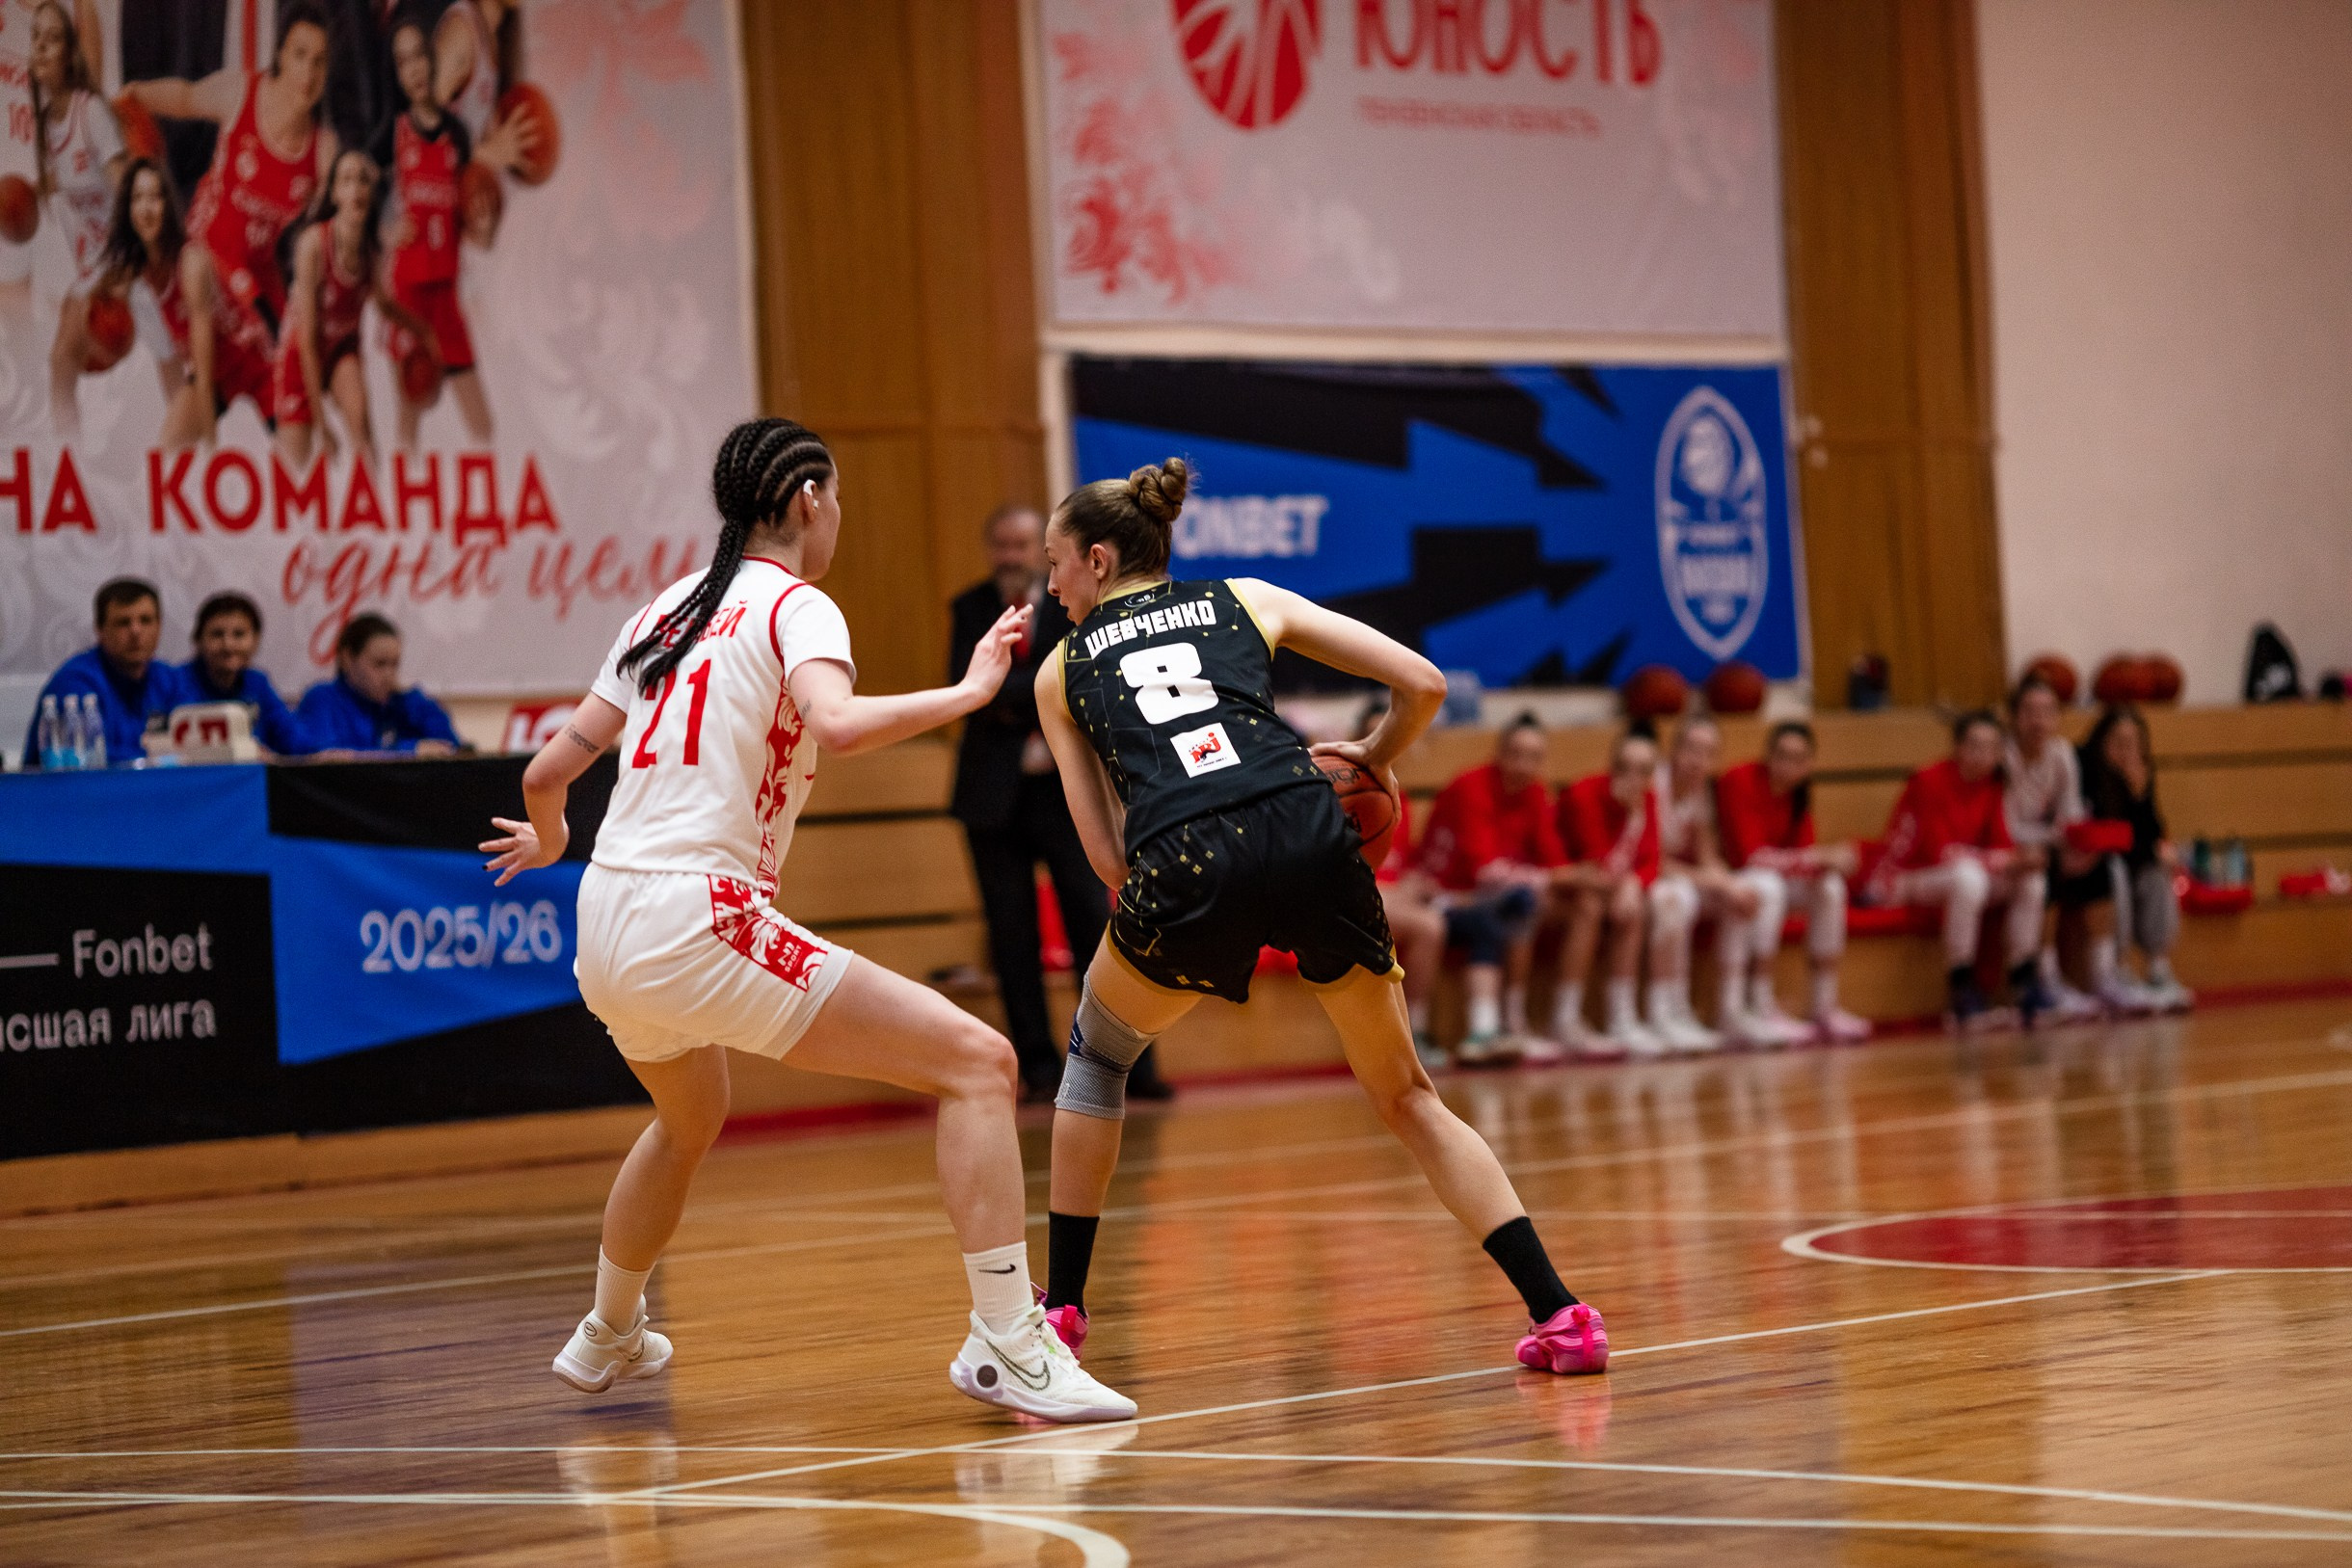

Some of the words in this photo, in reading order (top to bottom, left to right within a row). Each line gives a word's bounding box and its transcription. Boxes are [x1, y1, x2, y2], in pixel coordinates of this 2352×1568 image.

[147, 448, 561, 548] КОМАНДА
[1172, 494, 1329, 559] ONBET
[281, 536, 504, 666] одна
[1084, 599, 1216, 660] ШЕВЧЕНКО
[631, 658, 711, 769] 21
[1119, 642, 1219, 725] 8
[72, 921, 214, 979] Fonbet
[360, 898, 563, 973] 2025/26
[784, 944, 802, 973] SPORT
[125, 998, 218, 1044] лига
